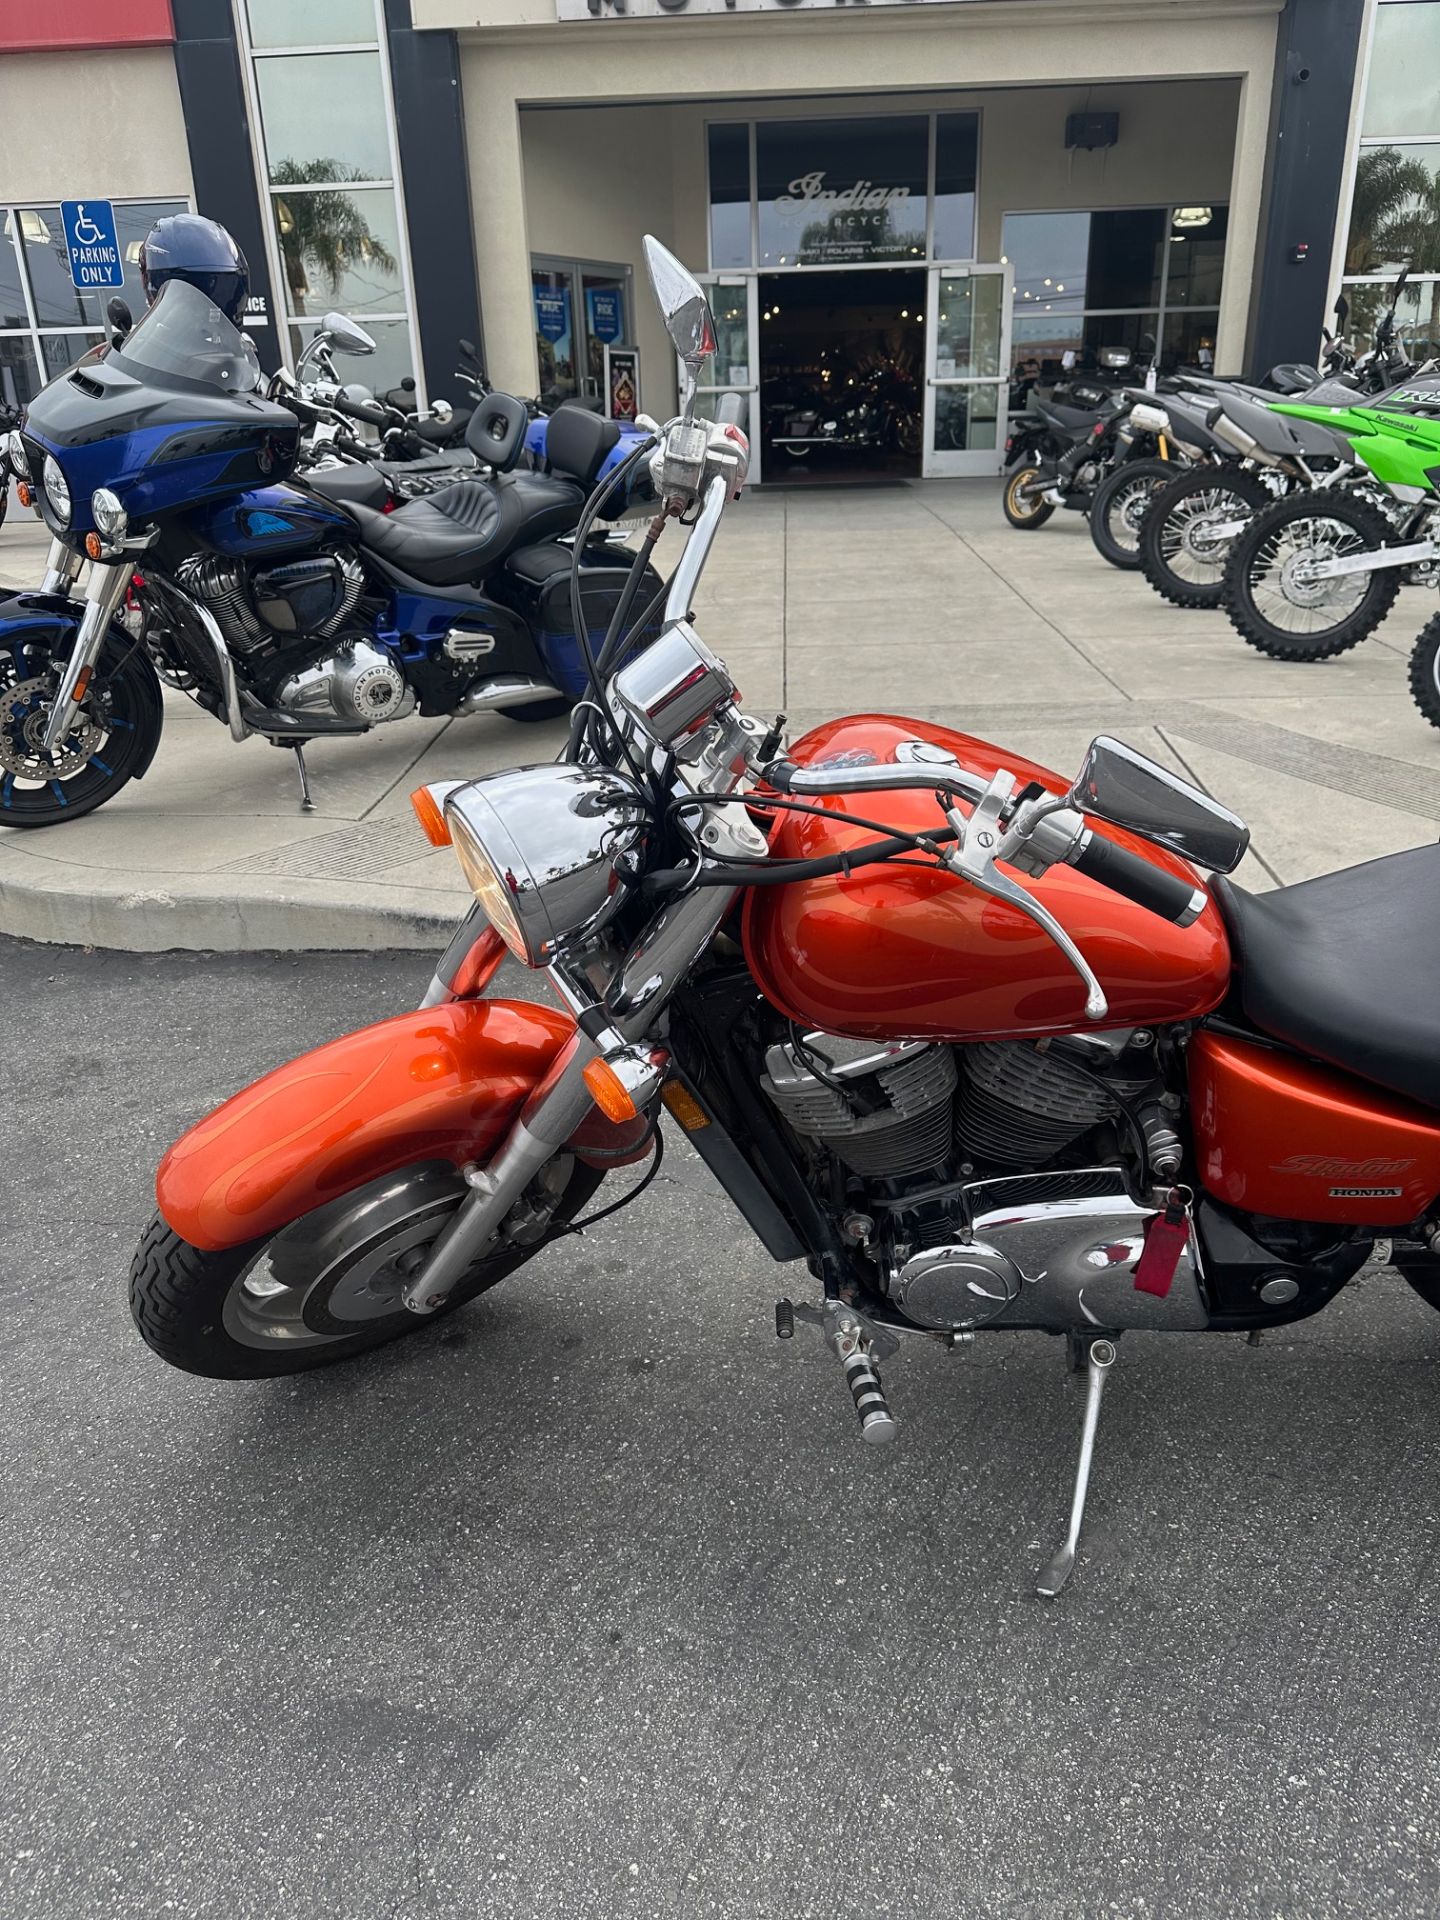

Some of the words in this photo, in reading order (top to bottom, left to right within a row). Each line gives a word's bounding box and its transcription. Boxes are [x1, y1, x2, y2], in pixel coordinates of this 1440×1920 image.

[773, 171, 911, 216] Indian
[71, 246, 116, 264] PARKING
[870, 245, 908, 254] VICTORY
[81, 266, 112, 283] ONLY
[1375, 413, 1419, 432] Kawasaki
[354, 677, 366, 712] INDIAN
[1268, 1154, 1417, 1180] Shadow
[1332, 1188, 1400, 1197] HONDA
